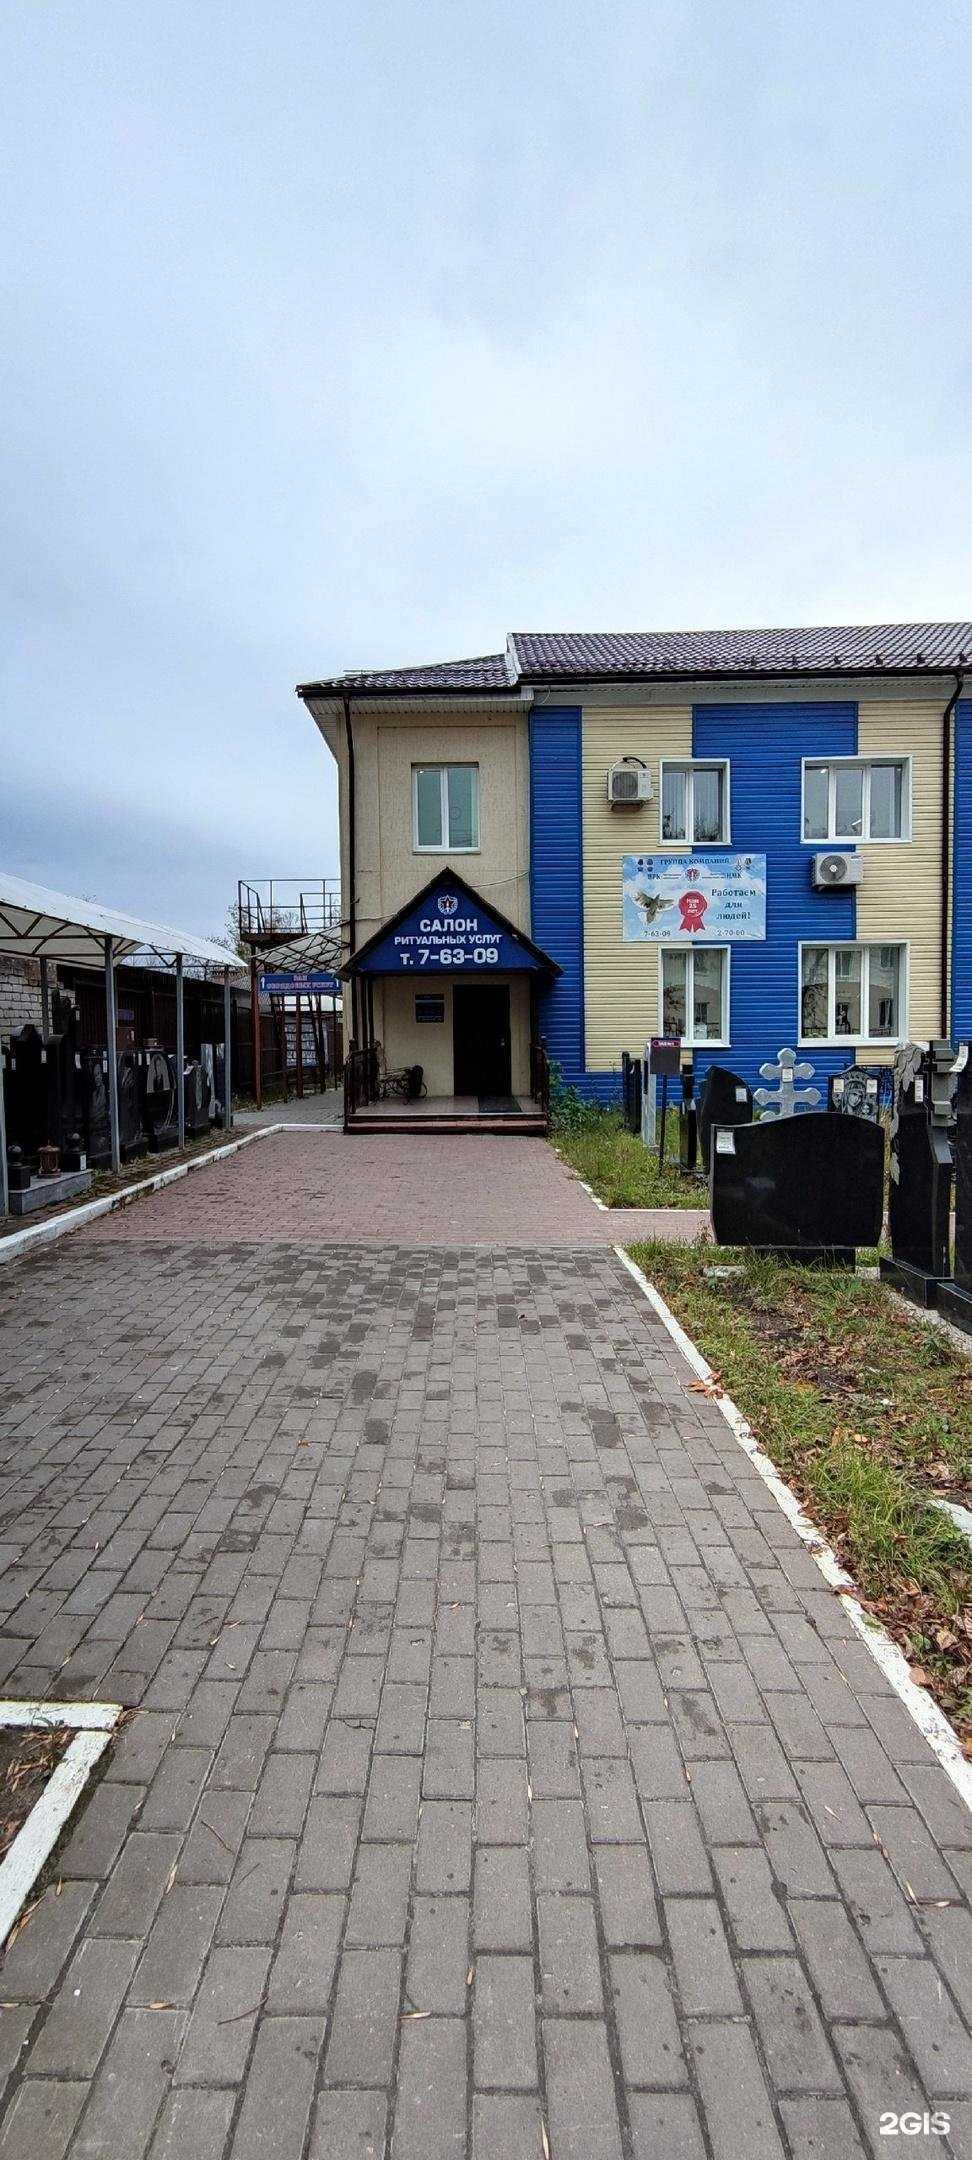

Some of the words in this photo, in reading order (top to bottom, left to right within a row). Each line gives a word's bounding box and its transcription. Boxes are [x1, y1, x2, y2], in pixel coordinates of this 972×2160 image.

[689, 857, 729, 865] КОМПАНИЙ
[711, 887, 756, 897] Работаем
[724, 901, 743, 909] для
[716, 911, 751, 920] людей!
[420, 918, 478, 932] САЛОН
[394, 935, 467, 946] РИТУАЛЬНЫХ
[468, 934, 502, 945] УСЛУГ
[418, 947, 499, 965] 7-63-09
